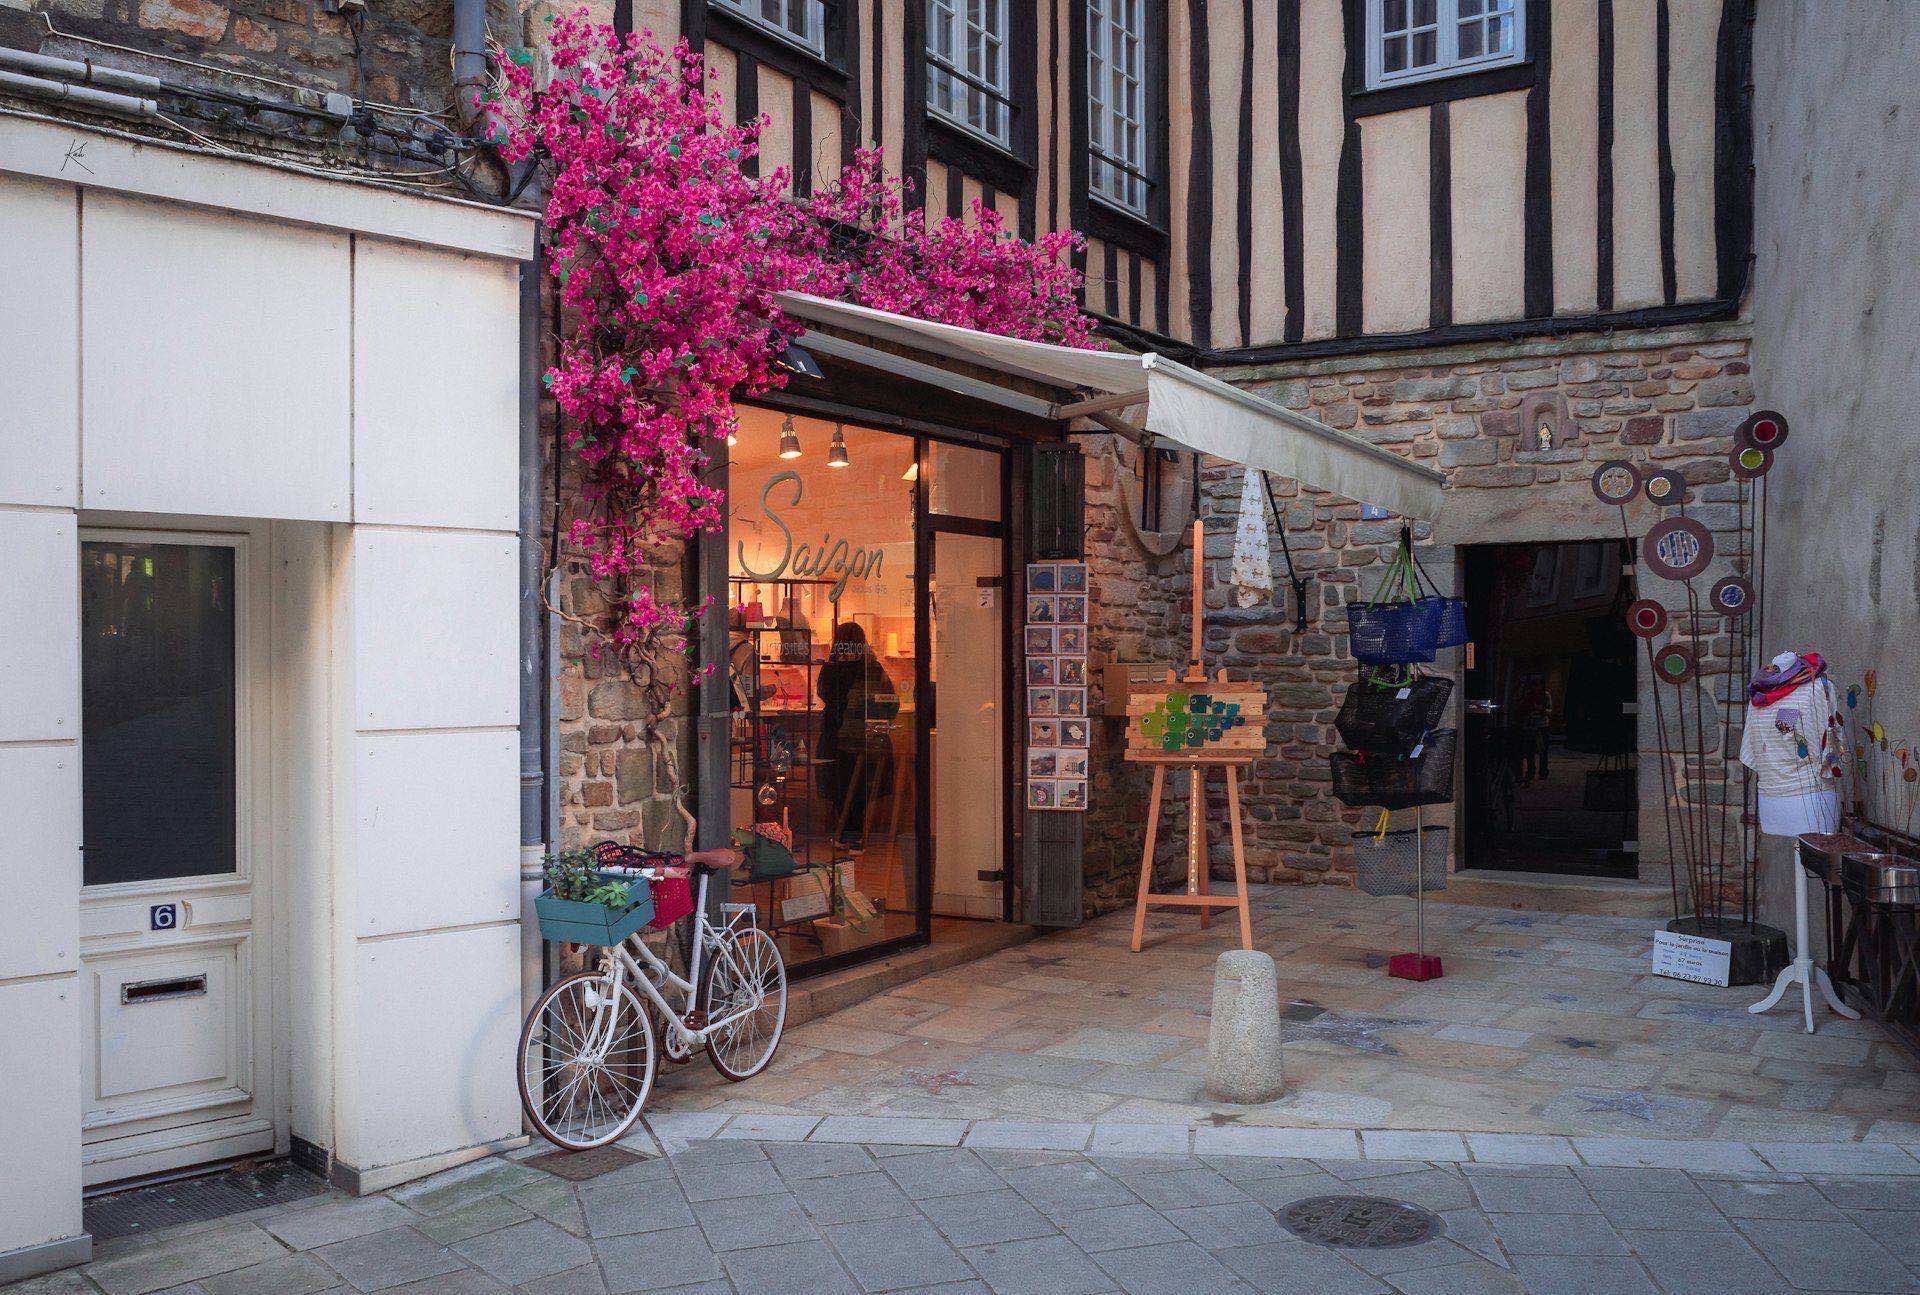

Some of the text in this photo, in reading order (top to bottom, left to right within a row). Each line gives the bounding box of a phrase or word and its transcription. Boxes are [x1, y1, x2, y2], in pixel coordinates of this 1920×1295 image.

[738, 471, 883, 602] Saigon
[155, 905, 173, 927] 6
[1709, 948, 1729, 957] maison
